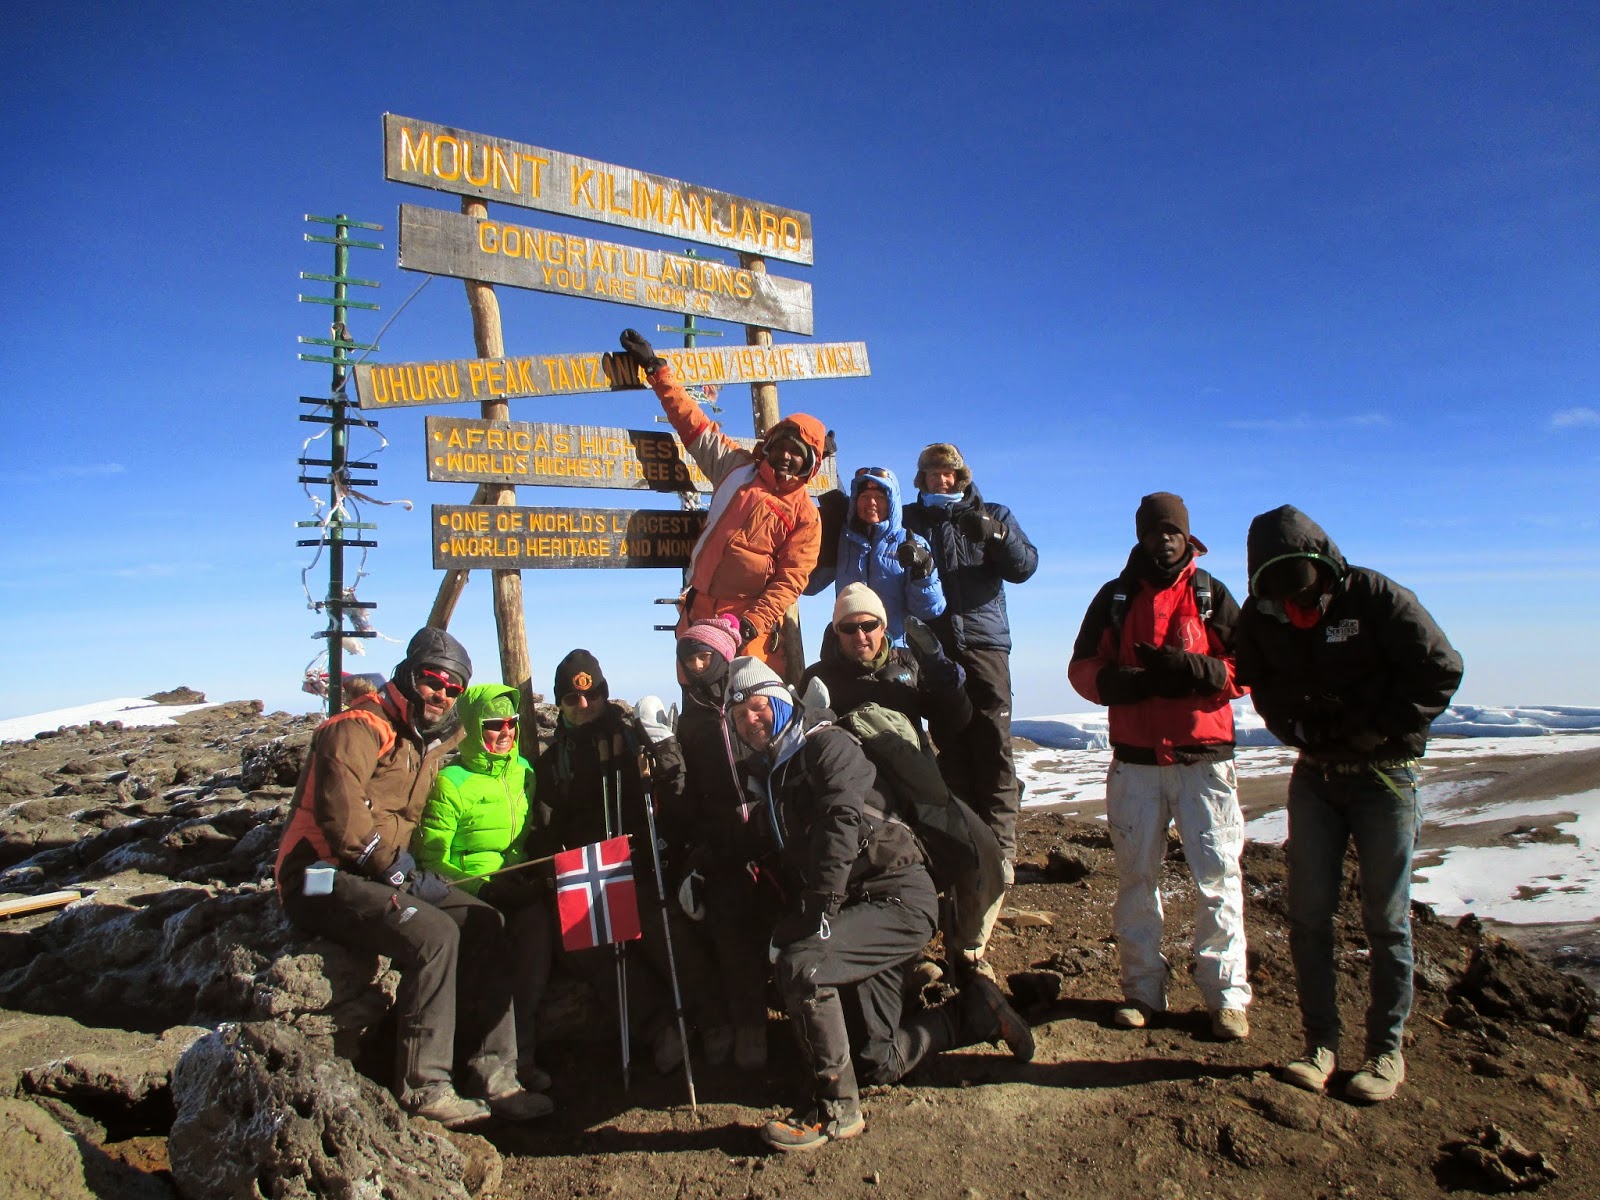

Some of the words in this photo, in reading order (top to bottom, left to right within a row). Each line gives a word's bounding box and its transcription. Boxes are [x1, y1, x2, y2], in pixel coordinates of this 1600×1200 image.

[401, 127, 549, 198] MOUNT
[571, 165, 802, 252] KILIMANJARO
[479, 221, 753, 299] CONGRATULATIONS
[542, 265, 587, 291] YOU
[594, 277, 636, 300] ARE
[646, 285, 686, 308] NOW
[693, 294, 711, 312] AT
[371, 363, 461, 403] UHURU
[815, 346, 861, 374] AMSL
[580, 435, 685, 459] HIGHEST
[447, 452, 528, 474] WORLD'S
[534, 456, 615, 478] HIGHEST
[623, 460, 669, 481] FREE
[451, 511, 489, 532] ONE
[496, 512, 522, 532] OF
[529, 512, 607, 533] WORLD'S
[612, 514, 691, 534] LARGEST
[450, 537, 520, 557] WORLD
[526, 537, 611, 557] HERITAGE
[619, 538, 652, 557] AND
